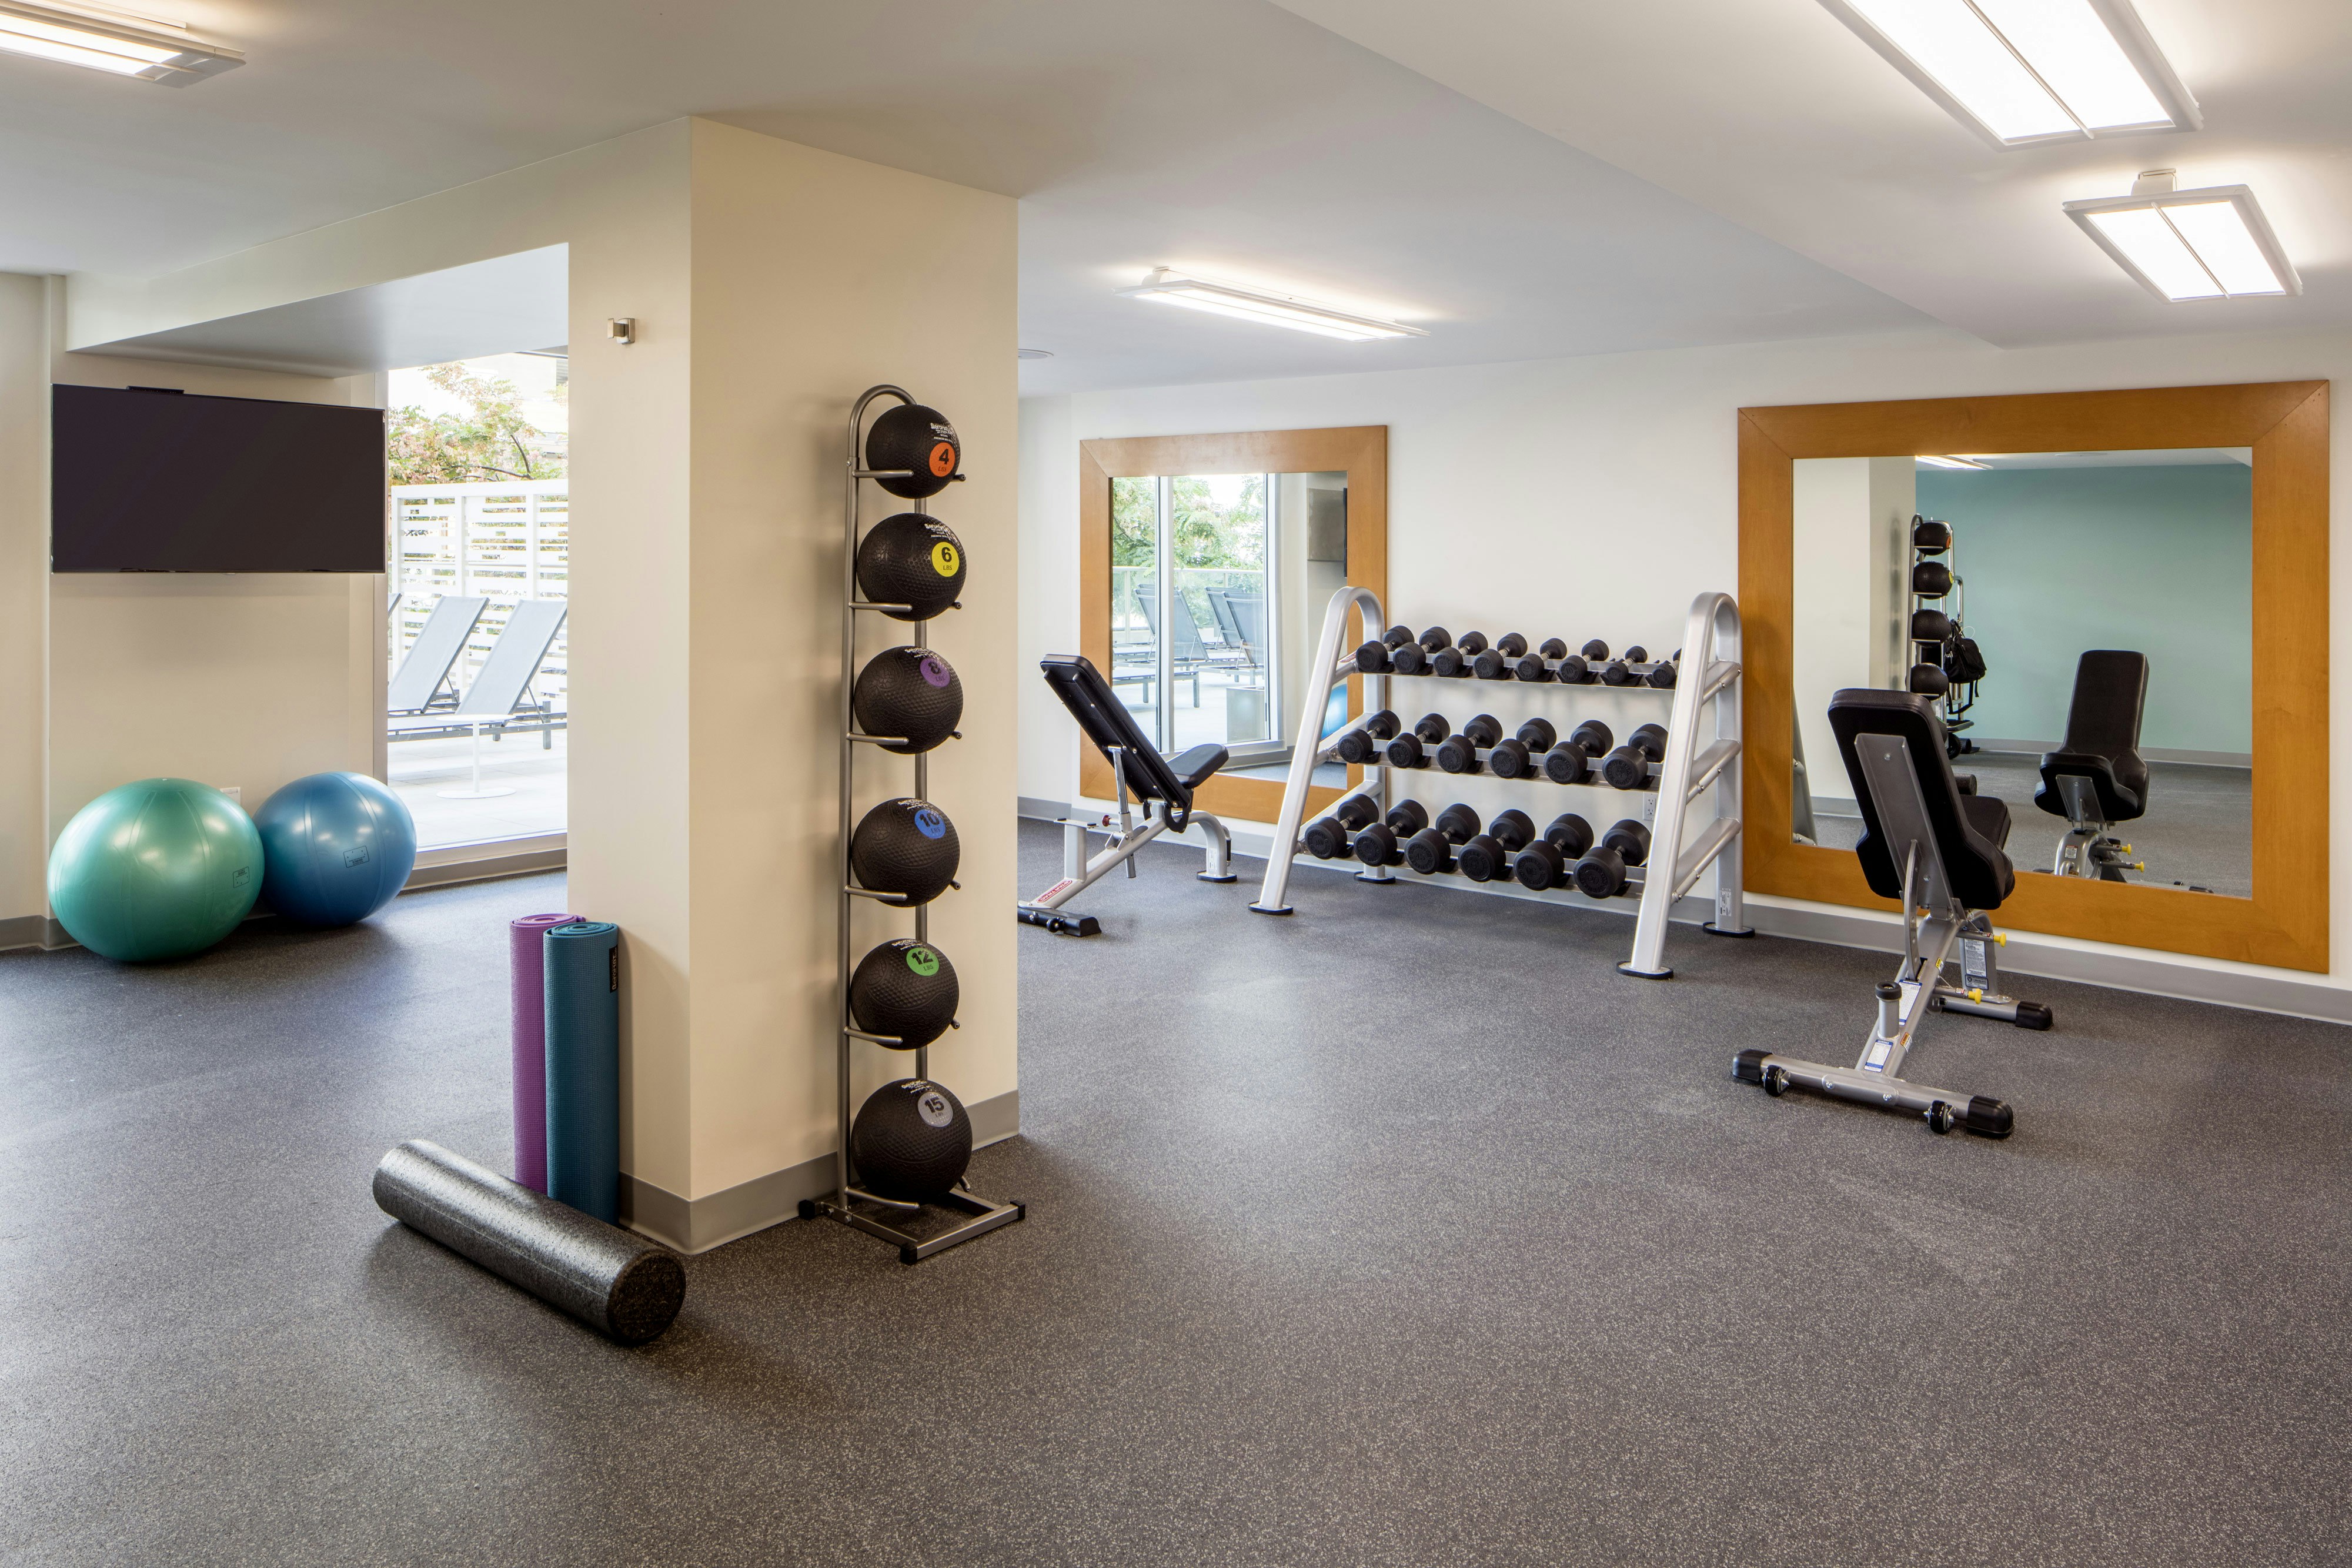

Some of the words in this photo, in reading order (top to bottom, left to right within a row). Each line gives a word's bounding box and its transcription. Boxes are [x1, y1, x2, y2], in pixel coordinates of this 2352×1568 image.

[938, 449, 949, 464] 4
[941, 547, 952, 562] 6
[928, 661, 941, 674] 8
[919, 813, 939, 827] 10
[1055, 881, 1070, 891] STAR
[911, 950, 933, 965] 12
[924, 1097, 944, 1114] 15
